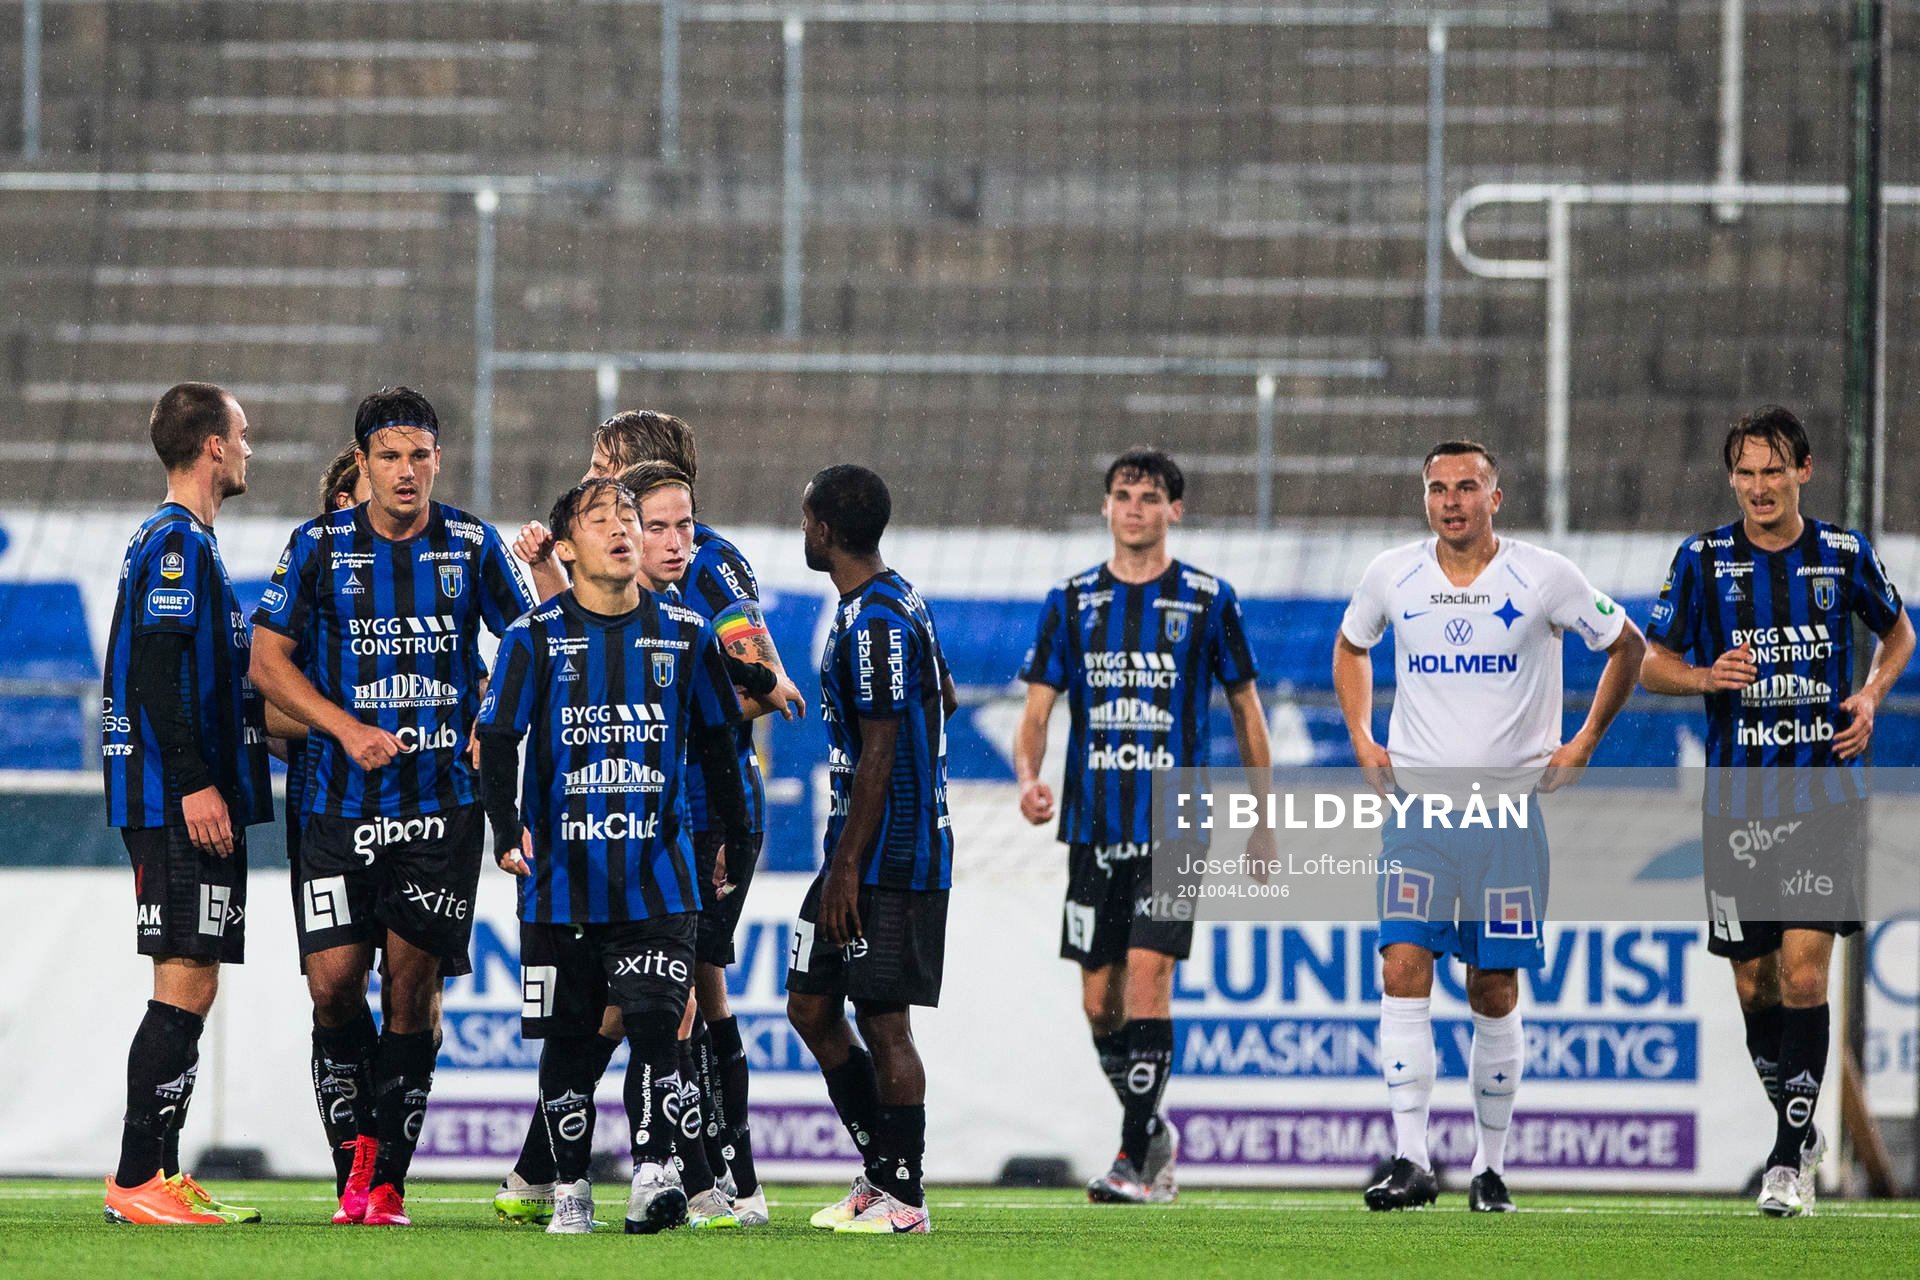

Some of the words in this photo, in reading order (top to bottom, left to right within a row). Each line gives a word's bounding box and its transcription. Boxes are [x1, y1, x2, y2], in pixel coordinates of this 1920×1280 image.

[325, 521, 357, 536] tmpl
[1706, 536, 1735, 549] tmpl
[716, 562, 750, 599] stad
[153, 595, 189, 605] UNIBET
[341, 587, 366, 595] SELECT
[1430, 592, 1490, 605] stadium
[533, 605, 564, 622] tmpl
[349, 618, 400, 635] BYGG
[350, 634, 459, 655] CONSTRUCT
[634, 637, 690, 648] HÖGBERGS
[1731, 627, 1779, 647] BYGG
[1084, 652, 1128, 669] BYGG
[1408, 653, 1517, 673] HOLMEN
[1750, 642, 1834, 664] ONSTRUCT
[857, 629, 874, 700] stadium
[888, 629, 904, 700] stadium
[352, 673, 458, 699] BILDEMO
[558, 674, 580, 682] SELECT
[1086, 670, 1179, 689] CONSTRUCT
[380, 700, 387, 708] &
[388, 697, 459, 708] SERVICECENTER
[561, 705, 611, 725] BYGG
[396, 722, 458, 754] Club
[561, 725, 669, 745] CONSTRUCT
[1737, 716, 1834, 746] inkClub
[1088, 742, 1175, 770] inkClub
[561, 758, 666, 786] BILDEMO
[353, 816, 447, 866] gibon
[1783, 869, 1834, 897] xite
[621, 950, 688, 982] xite
[1172, 925, 1698, 1007] LUNVIST
[1453, 1020, 1678, 1078] RKTYG
